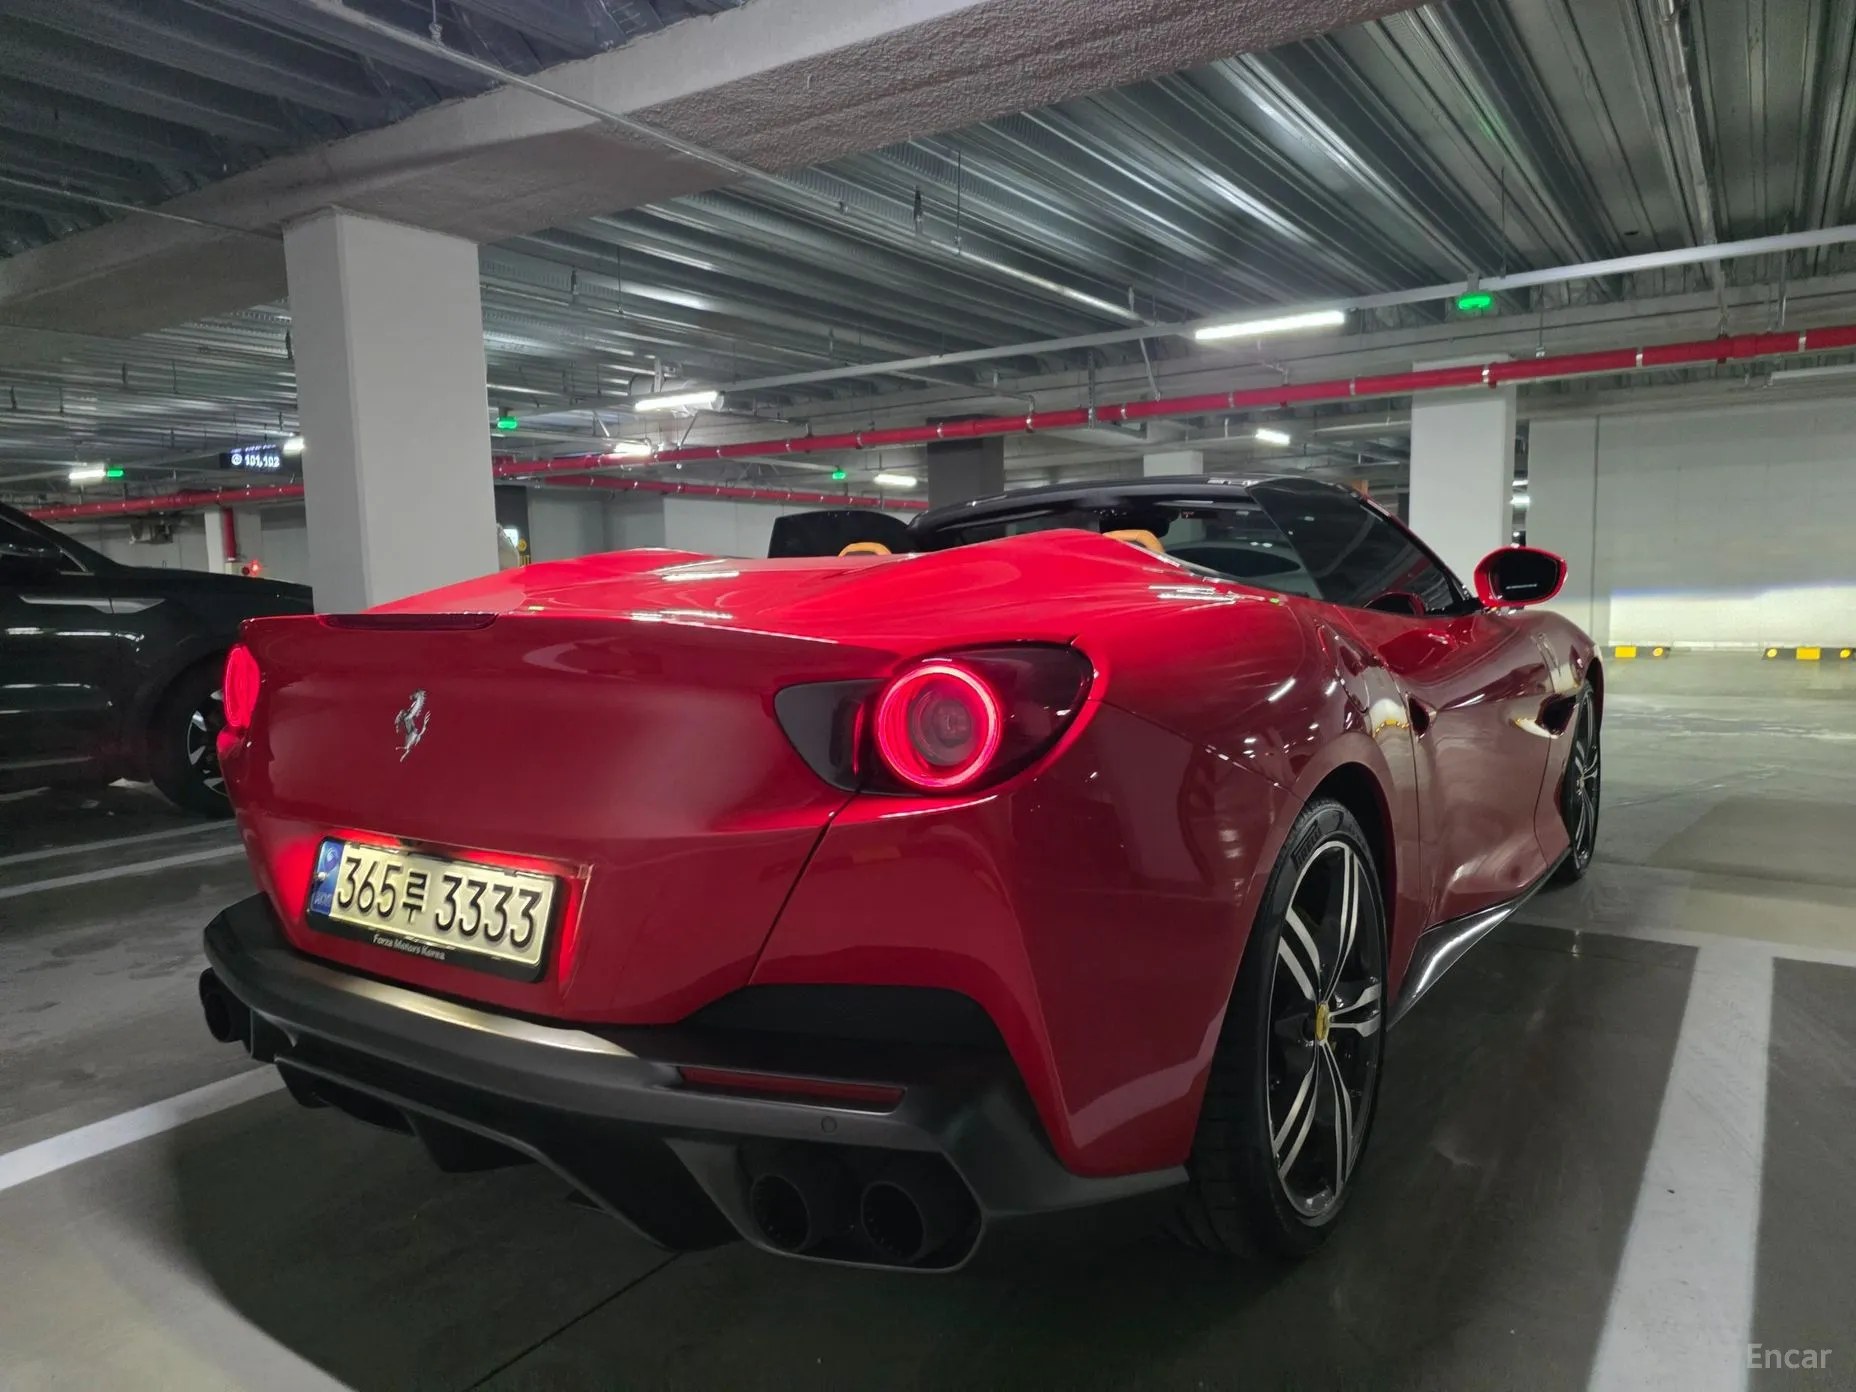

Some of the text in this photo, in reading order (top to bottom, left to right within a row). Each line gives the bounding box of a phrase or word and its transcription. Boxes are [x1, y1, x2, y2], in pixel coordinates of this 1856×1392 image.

[435, 874, 543, 948] 3333
[372, 933, 446, 960] Forza Motors Korea
